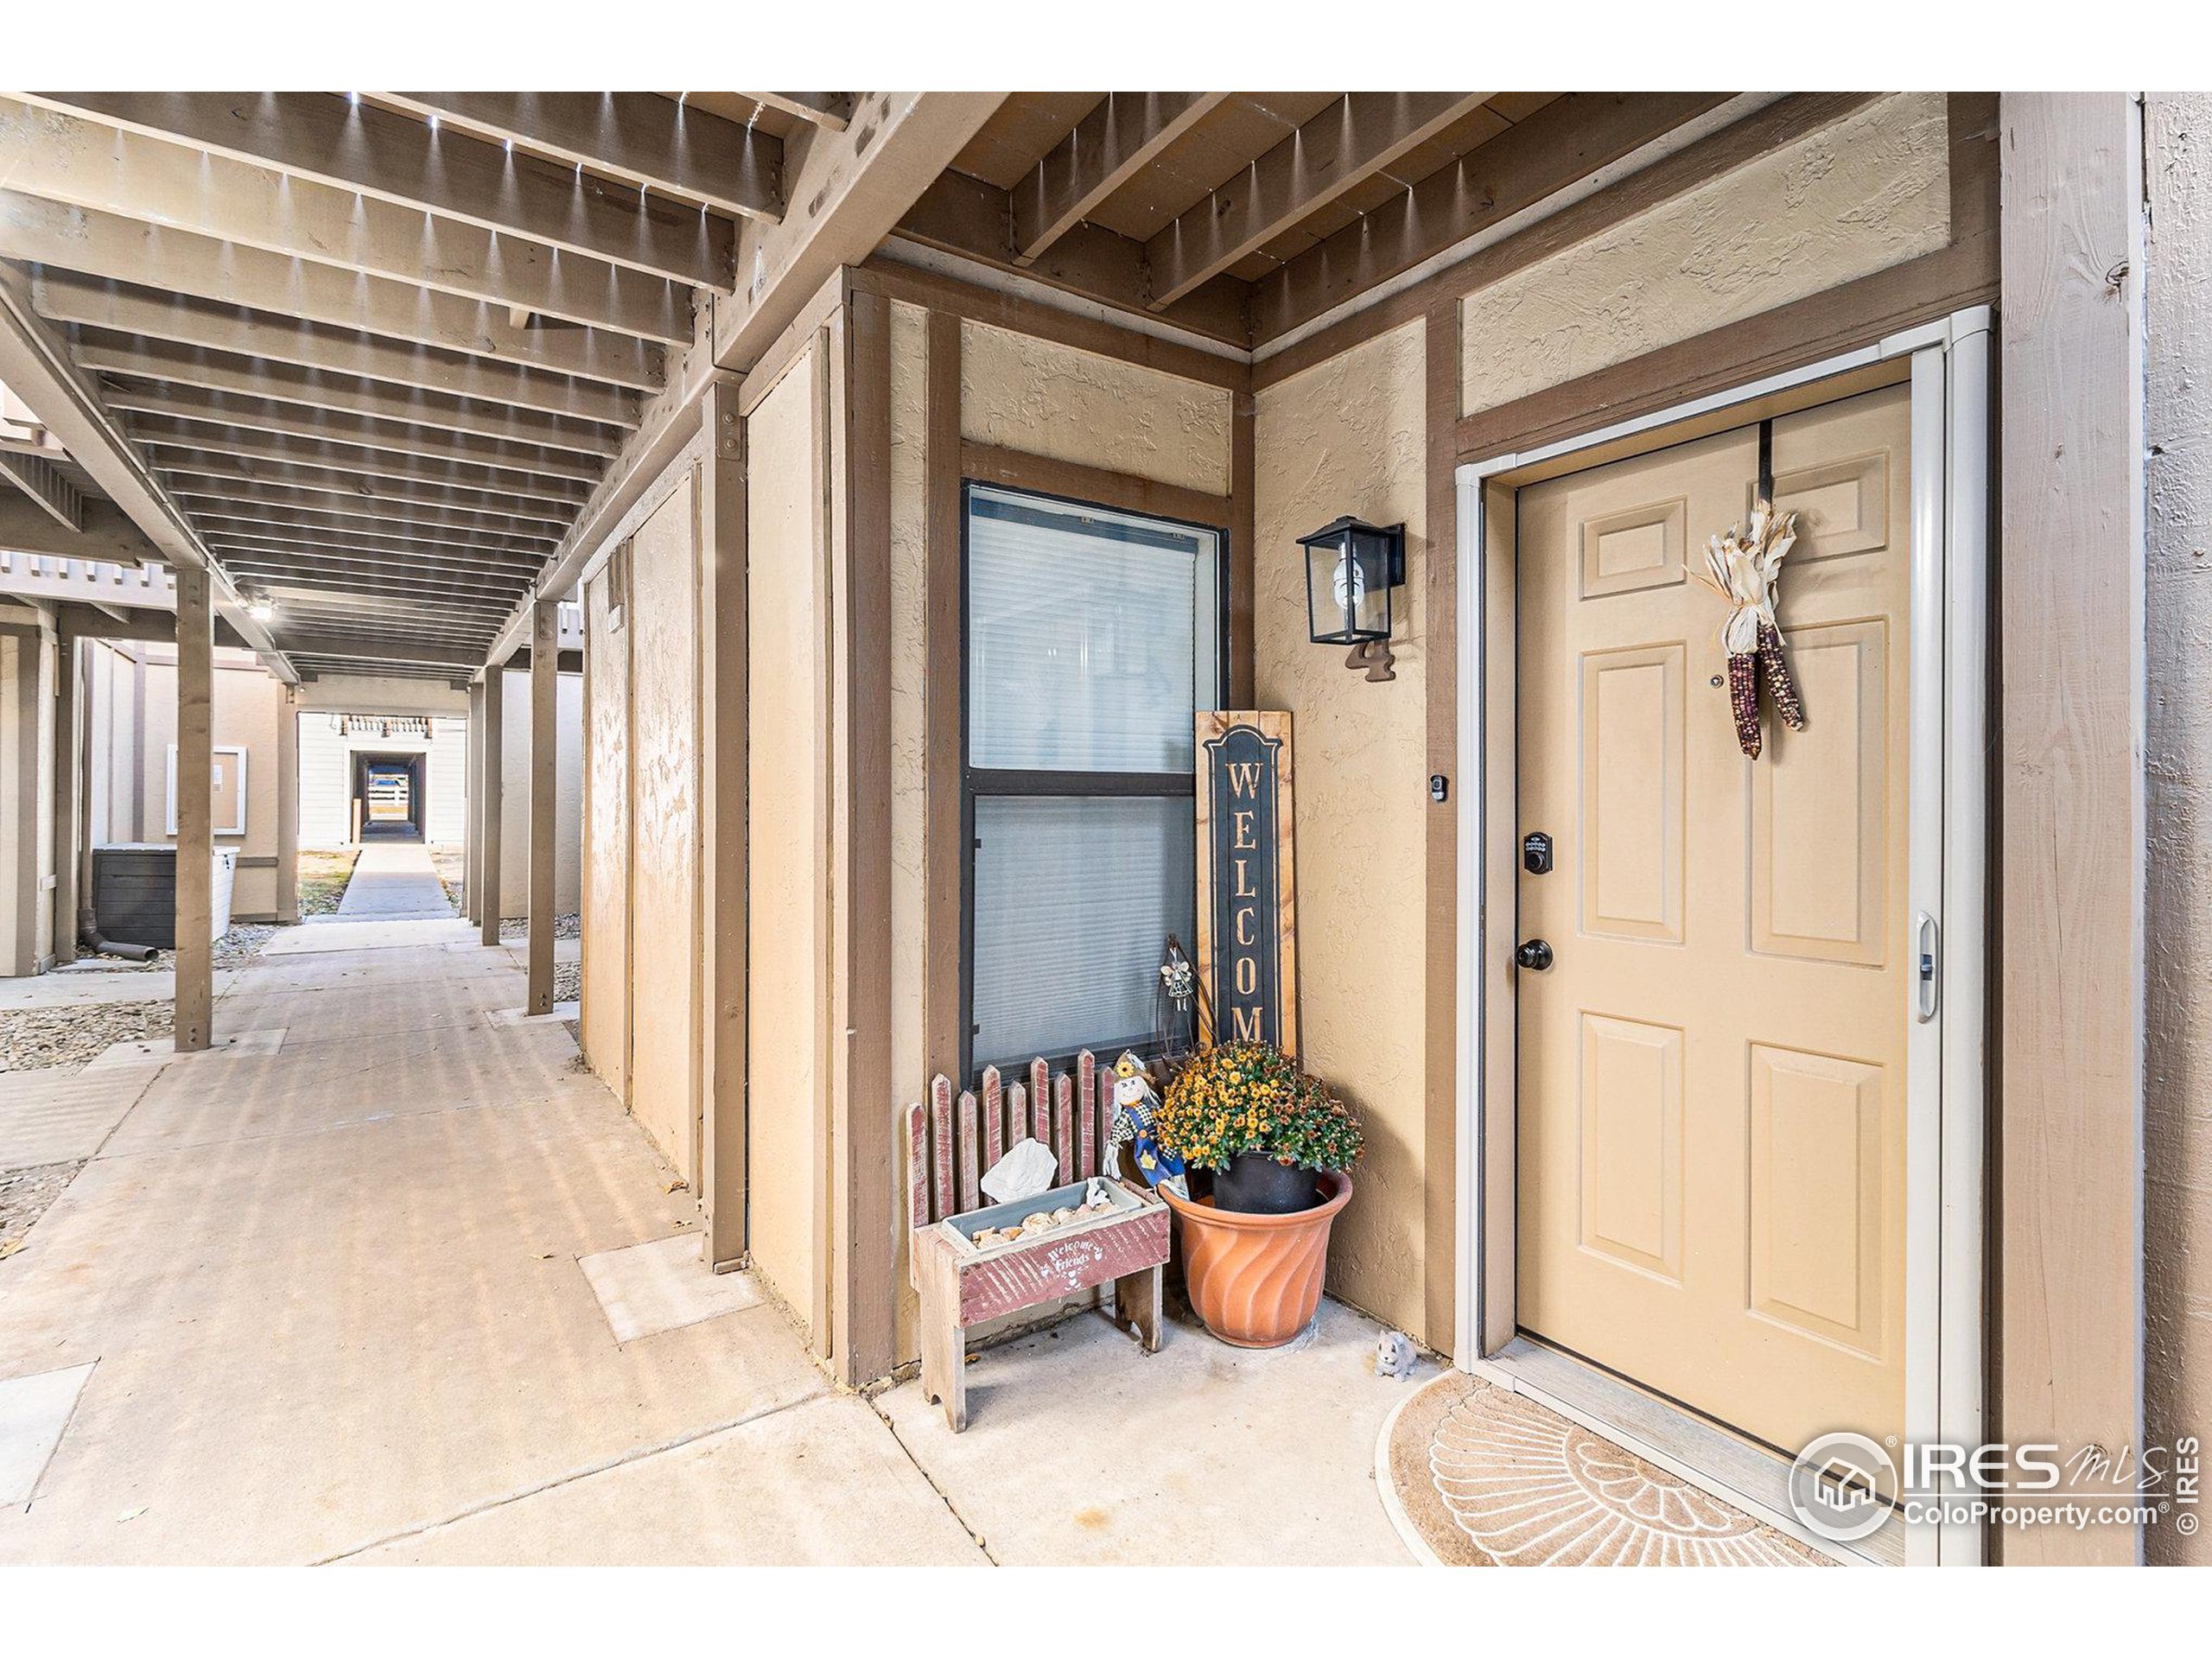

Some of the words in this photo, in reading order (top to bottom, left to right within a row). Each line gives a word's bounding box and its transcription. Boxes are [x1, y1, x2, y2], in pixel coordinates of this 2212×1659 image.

[1344, 638, 1395, 682] 4
[1225, 763, 1263, 1041] WELCOM
[1047, 1241, 1093, 1262] Welcome
